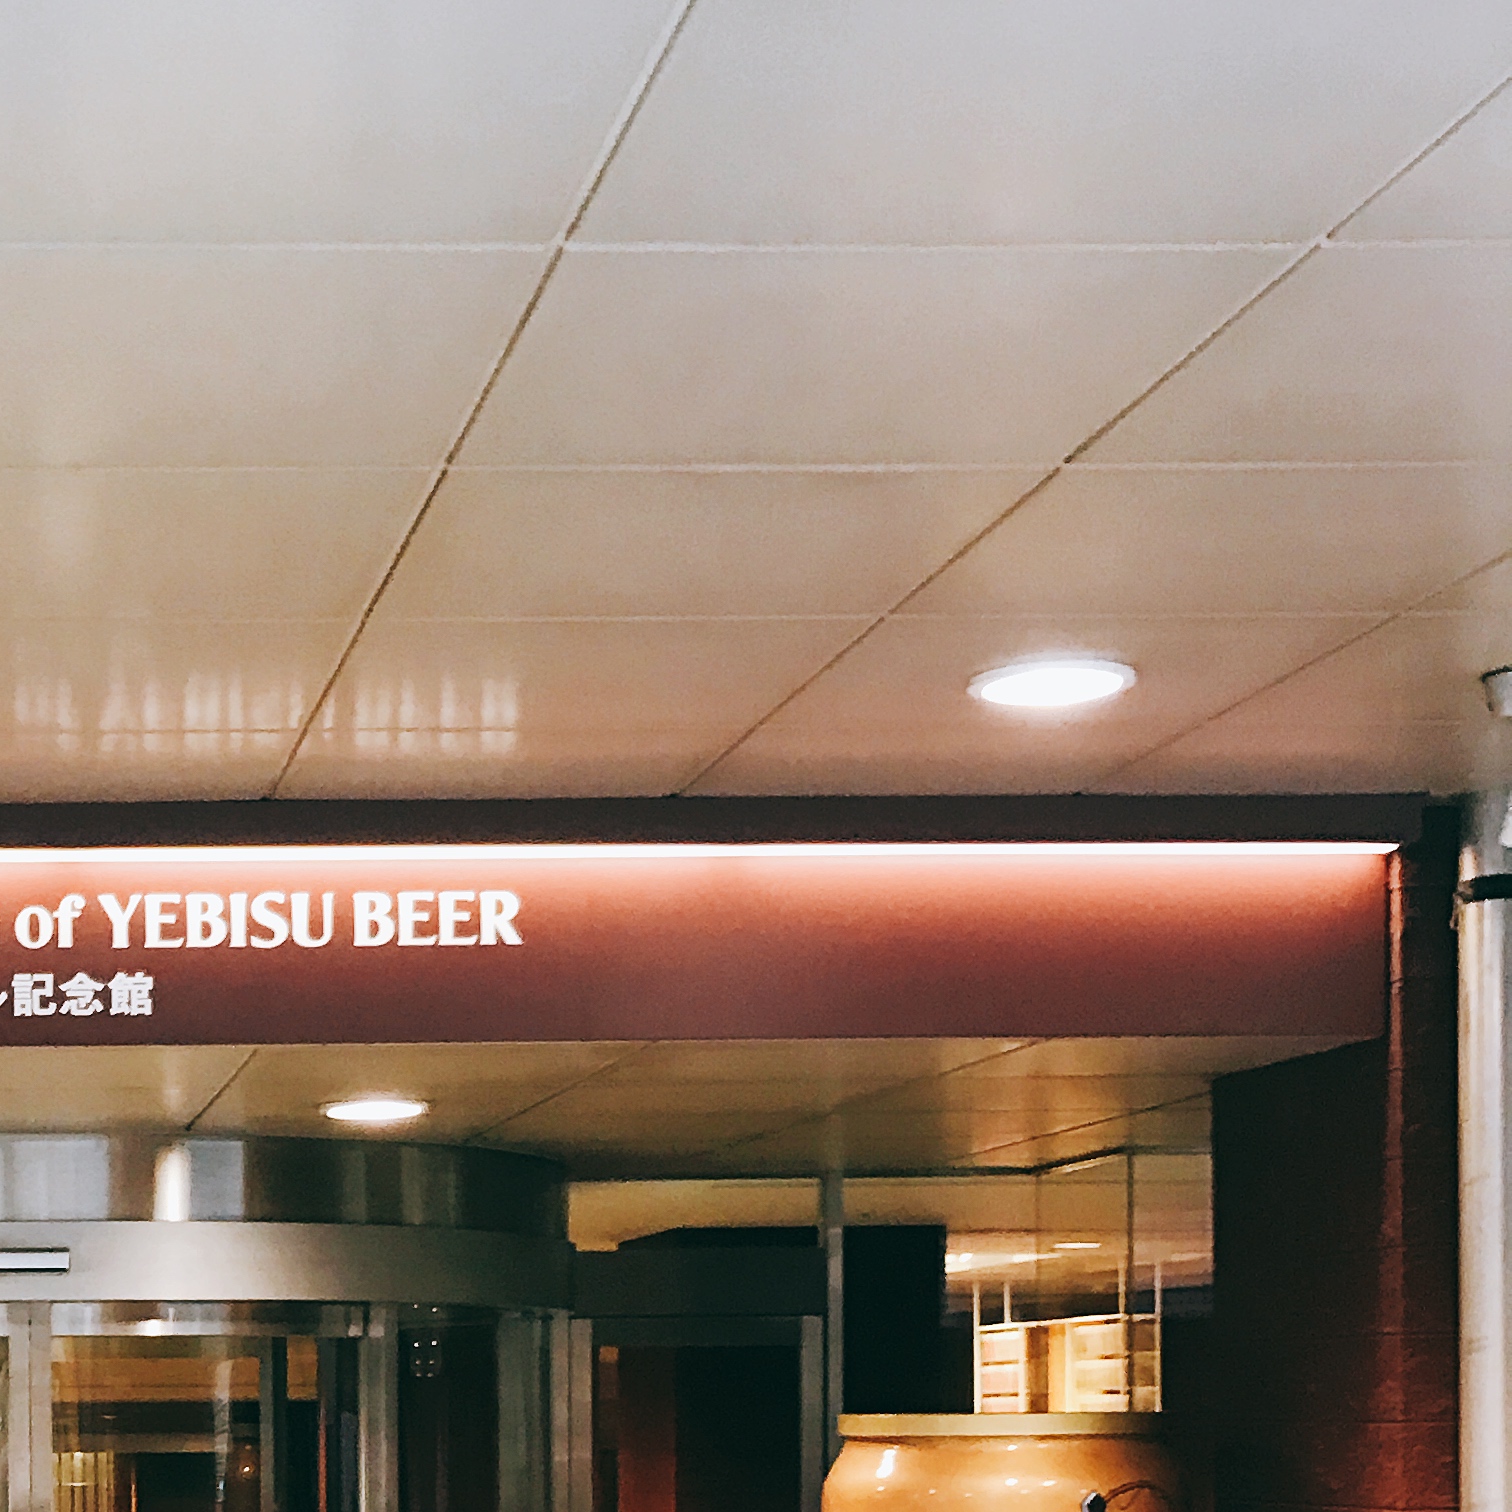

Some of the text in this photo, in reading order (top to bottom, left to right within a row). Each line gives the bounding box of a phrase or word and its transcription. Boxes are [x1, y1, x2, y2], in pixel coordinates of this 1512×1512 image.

[15, 893, 87, 950] of
[99, 890, 336, 949] YEBISU
[353, 889, 523, 947] BEER
